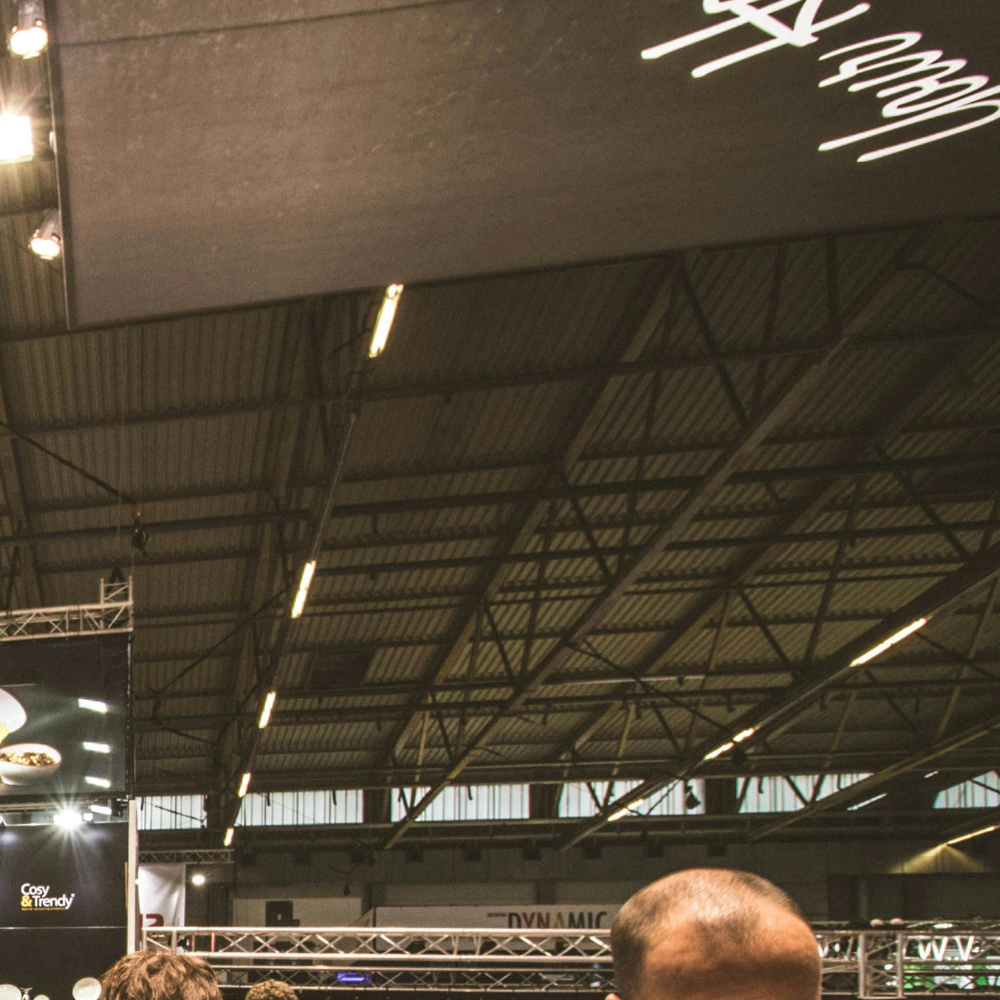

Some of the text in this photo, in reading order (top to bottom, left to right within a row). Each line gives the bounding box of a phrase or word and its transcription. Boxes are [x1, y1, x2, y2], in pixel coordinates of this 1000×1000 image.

[21, 883, 50, 898] Cosy
[20, 893, 73, 910] & Trendy
